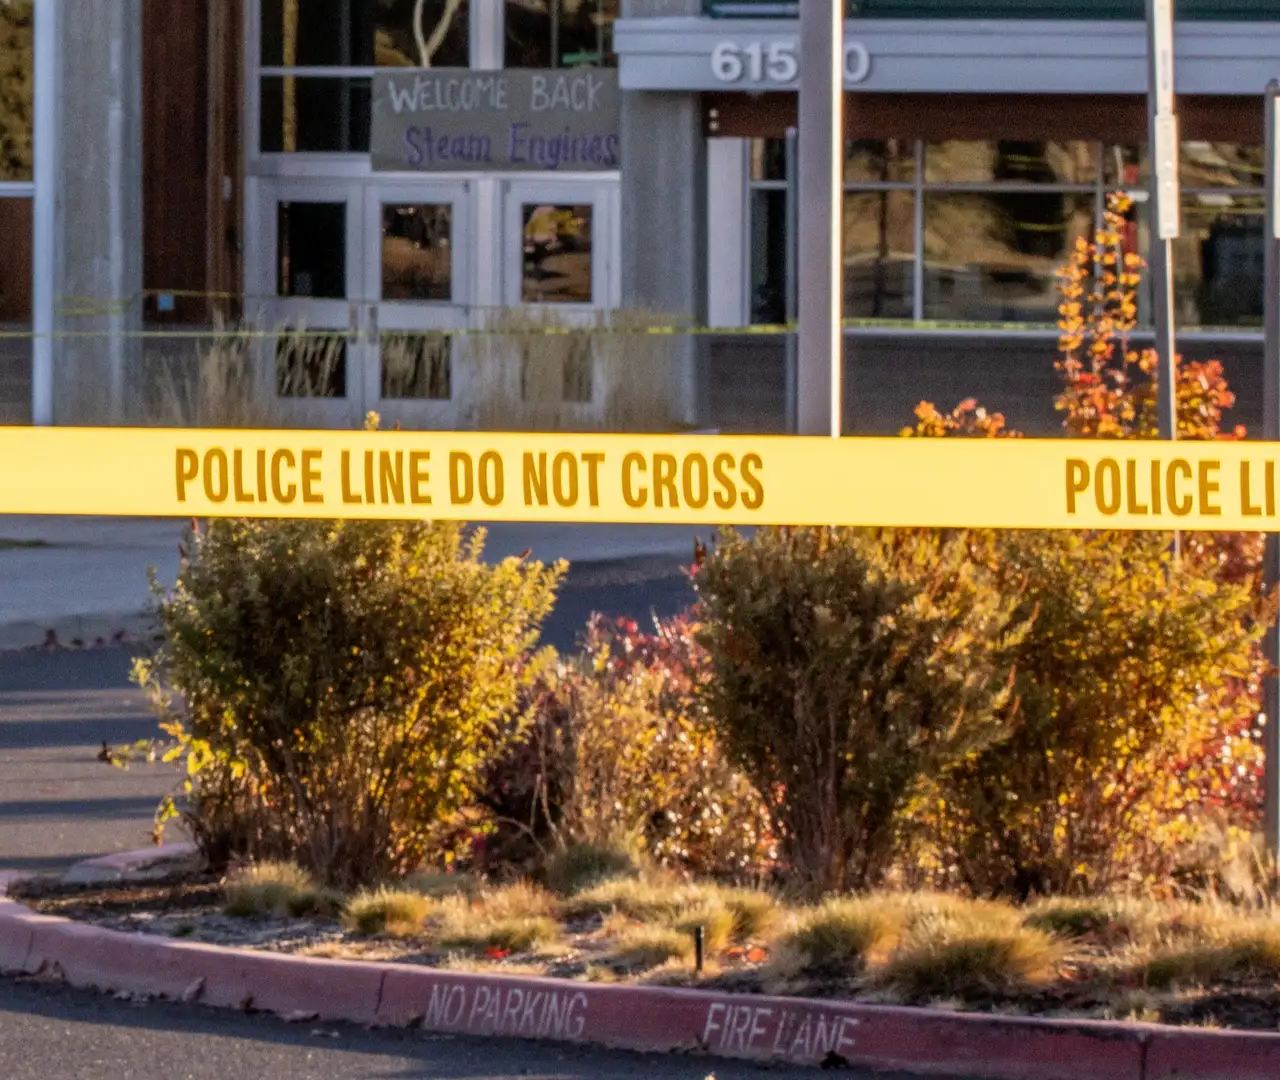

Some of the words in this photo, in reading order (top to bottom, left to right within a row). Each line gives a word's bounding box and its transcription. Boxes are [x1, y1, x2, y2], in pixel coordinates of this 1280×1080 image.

[711, 40, 870, 83] 6150
[389, 75, 509, 114] WELCOME
[530, 74, 604, 112] BACK
[404, 124, 492, 166] Steam
[509, 122, 620, 170] Engines
[175, 448, 324, 504] POLICE
[340, 450, 432, 504] LINE
[449, 450, 504, 507] DO
[522, 451, 605, 507] NOT
[621, 452, 765, 510] CROSS
[1065, 458, 1221, 516] POLICE
[424, 983, 467, 1028] NO
[469, 985, 589, 1039] PARKING
[703, 1001, 773, 1052] FIRE
[775, 1012, 860, 1057] LANE
